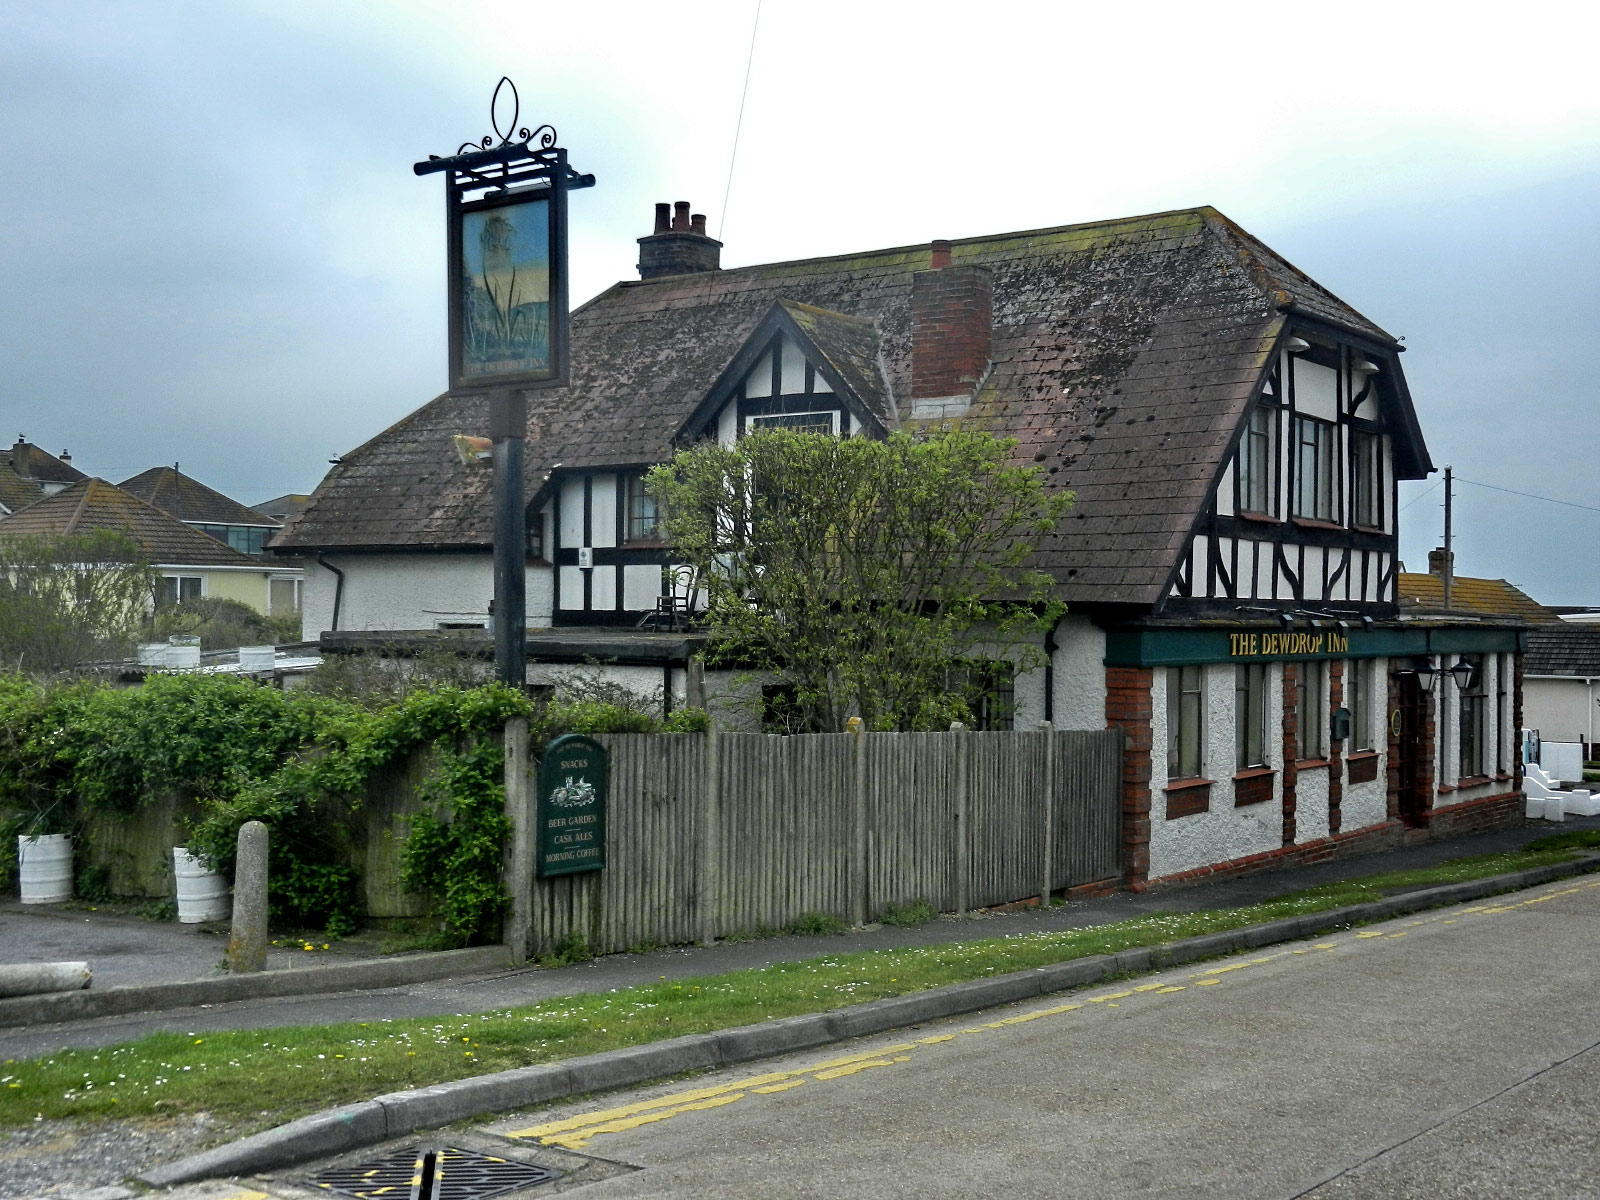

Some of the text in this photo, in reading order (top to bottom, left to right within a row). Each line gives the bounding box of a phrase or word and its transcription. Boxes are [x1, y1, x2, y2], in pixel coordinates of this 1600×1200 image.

[1230, 632, 1348, 656] THE DEWDROP INN
[560, 759, 588, 769] SNACKS
[548, 815, 597, 828] BEER GARDEN
[554, 831, 593, 845] CASK ALES
[545, 847, 600, 863] MORNING COFFEE
